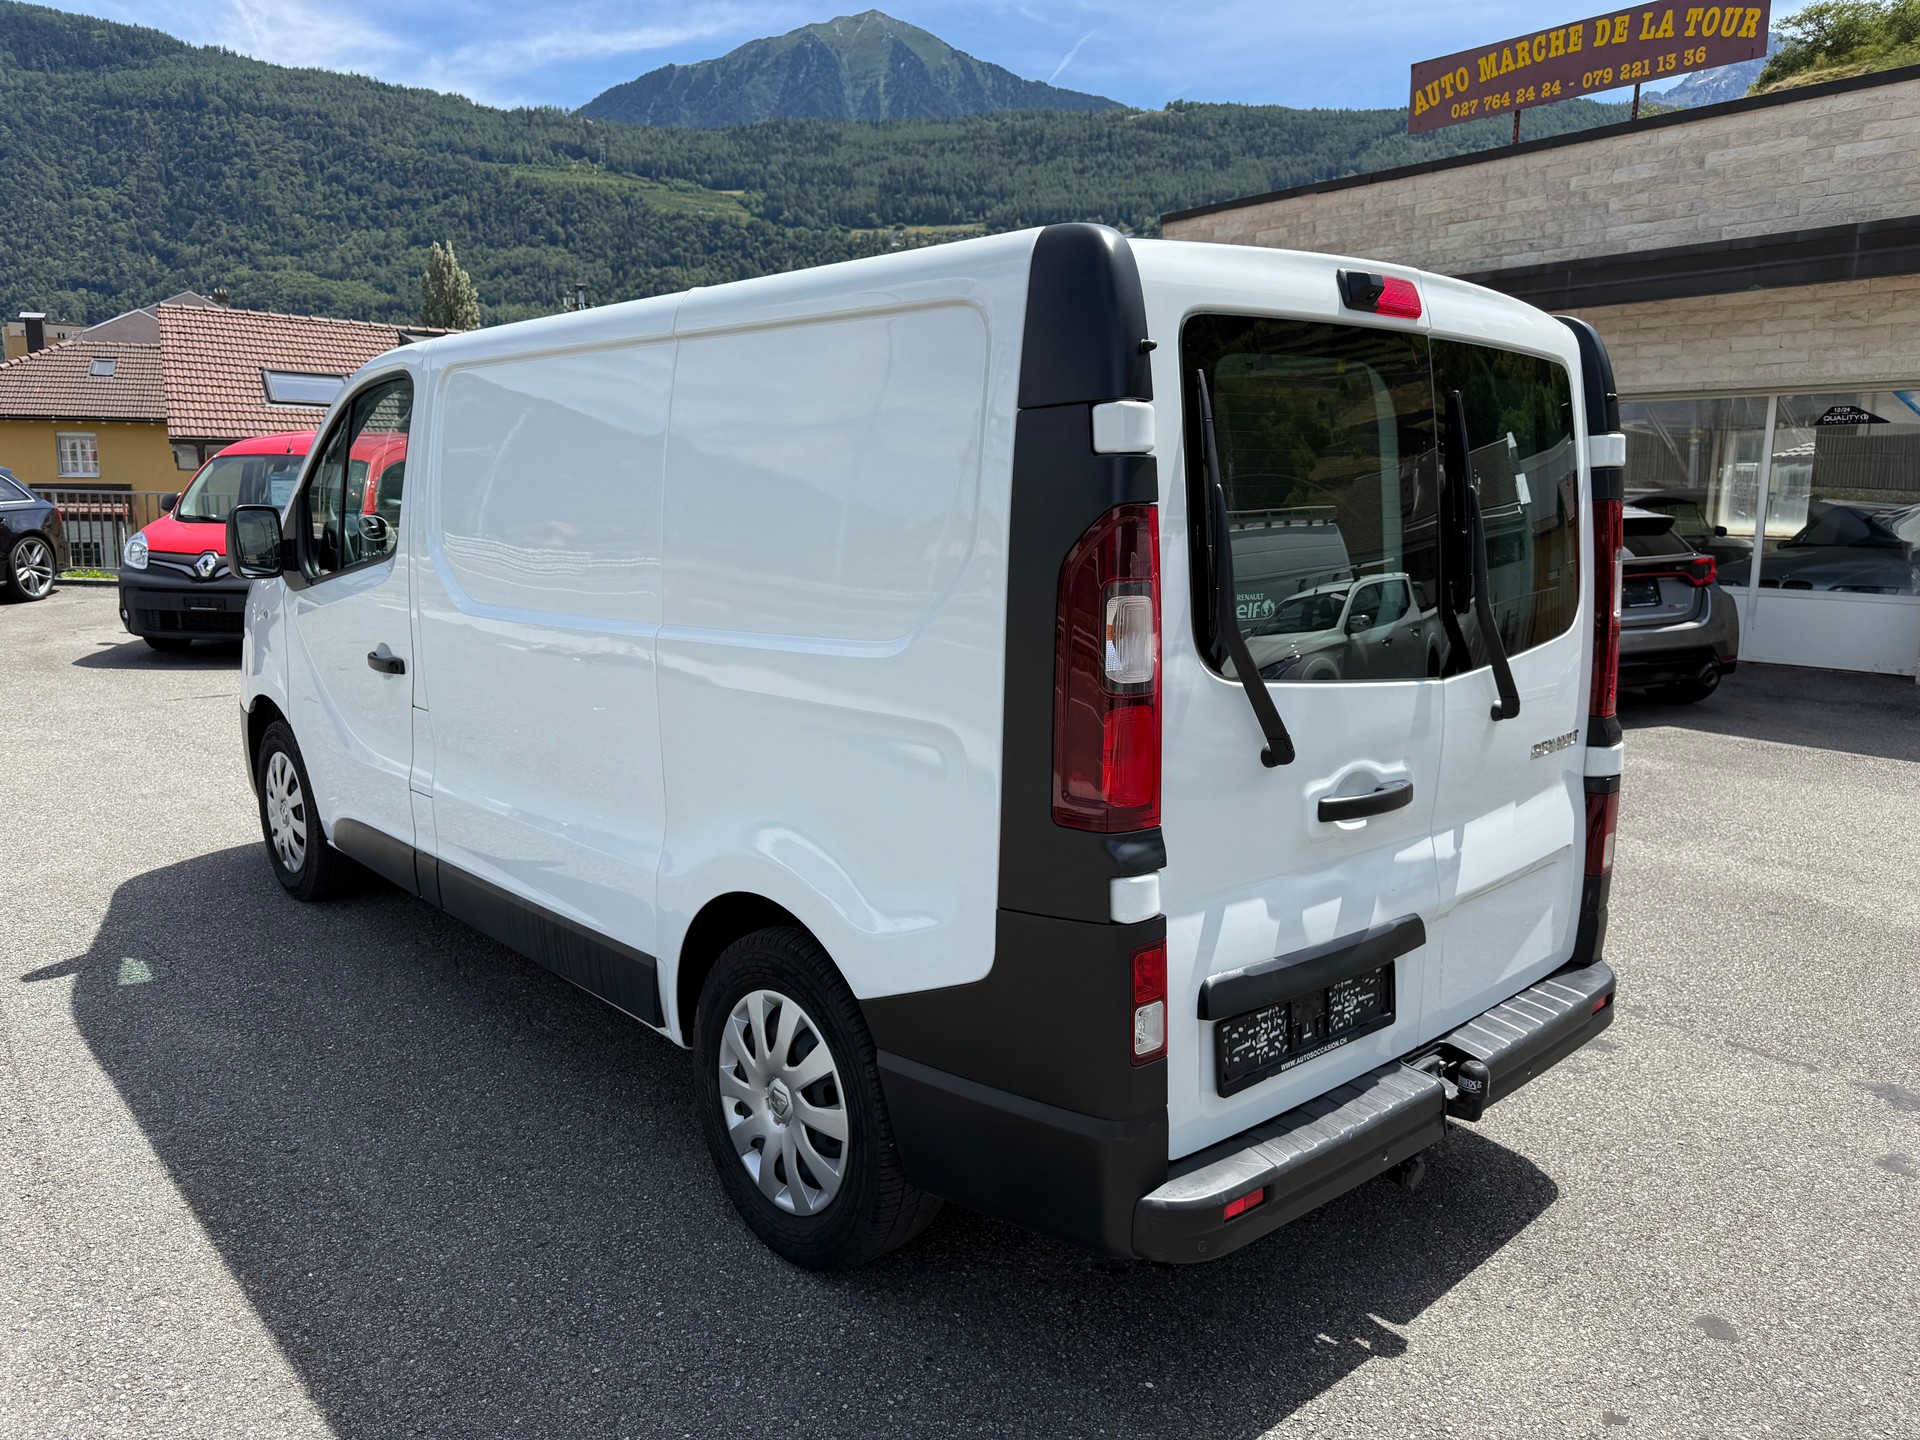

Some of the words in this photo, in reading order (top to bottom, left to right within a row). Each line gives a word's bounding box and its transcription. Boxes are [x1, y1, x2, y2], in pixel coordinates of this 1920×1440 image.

[1414, 66, 1470, 116] AUTO
[1477, 23, 1584, 83] MARCHE
[1593, 14, 1630, 48] DE
[1638, 9, 1675, 41] LA
[1684, 6, 1762, 39] TOUR
[1451, 99, 1479, 119] 027
[1483, 91, 1511, 111] 764
[1516, 85, 1536, 104] 24
[1541, 79, 1562, 98] 24
[1582, 67, 1614, 89] 079
[1619, 59, 1650, 81] 221
[1656, 53, 1677, 73] 13
[1683, 46, 1707, 67] 36
[1236, 601, 1261, 619] elf
[1237, 593, 1264, 601] RENAULT
[1280, 1036, 1348, 1071] WWW.AUTOSOCCASION.CH
